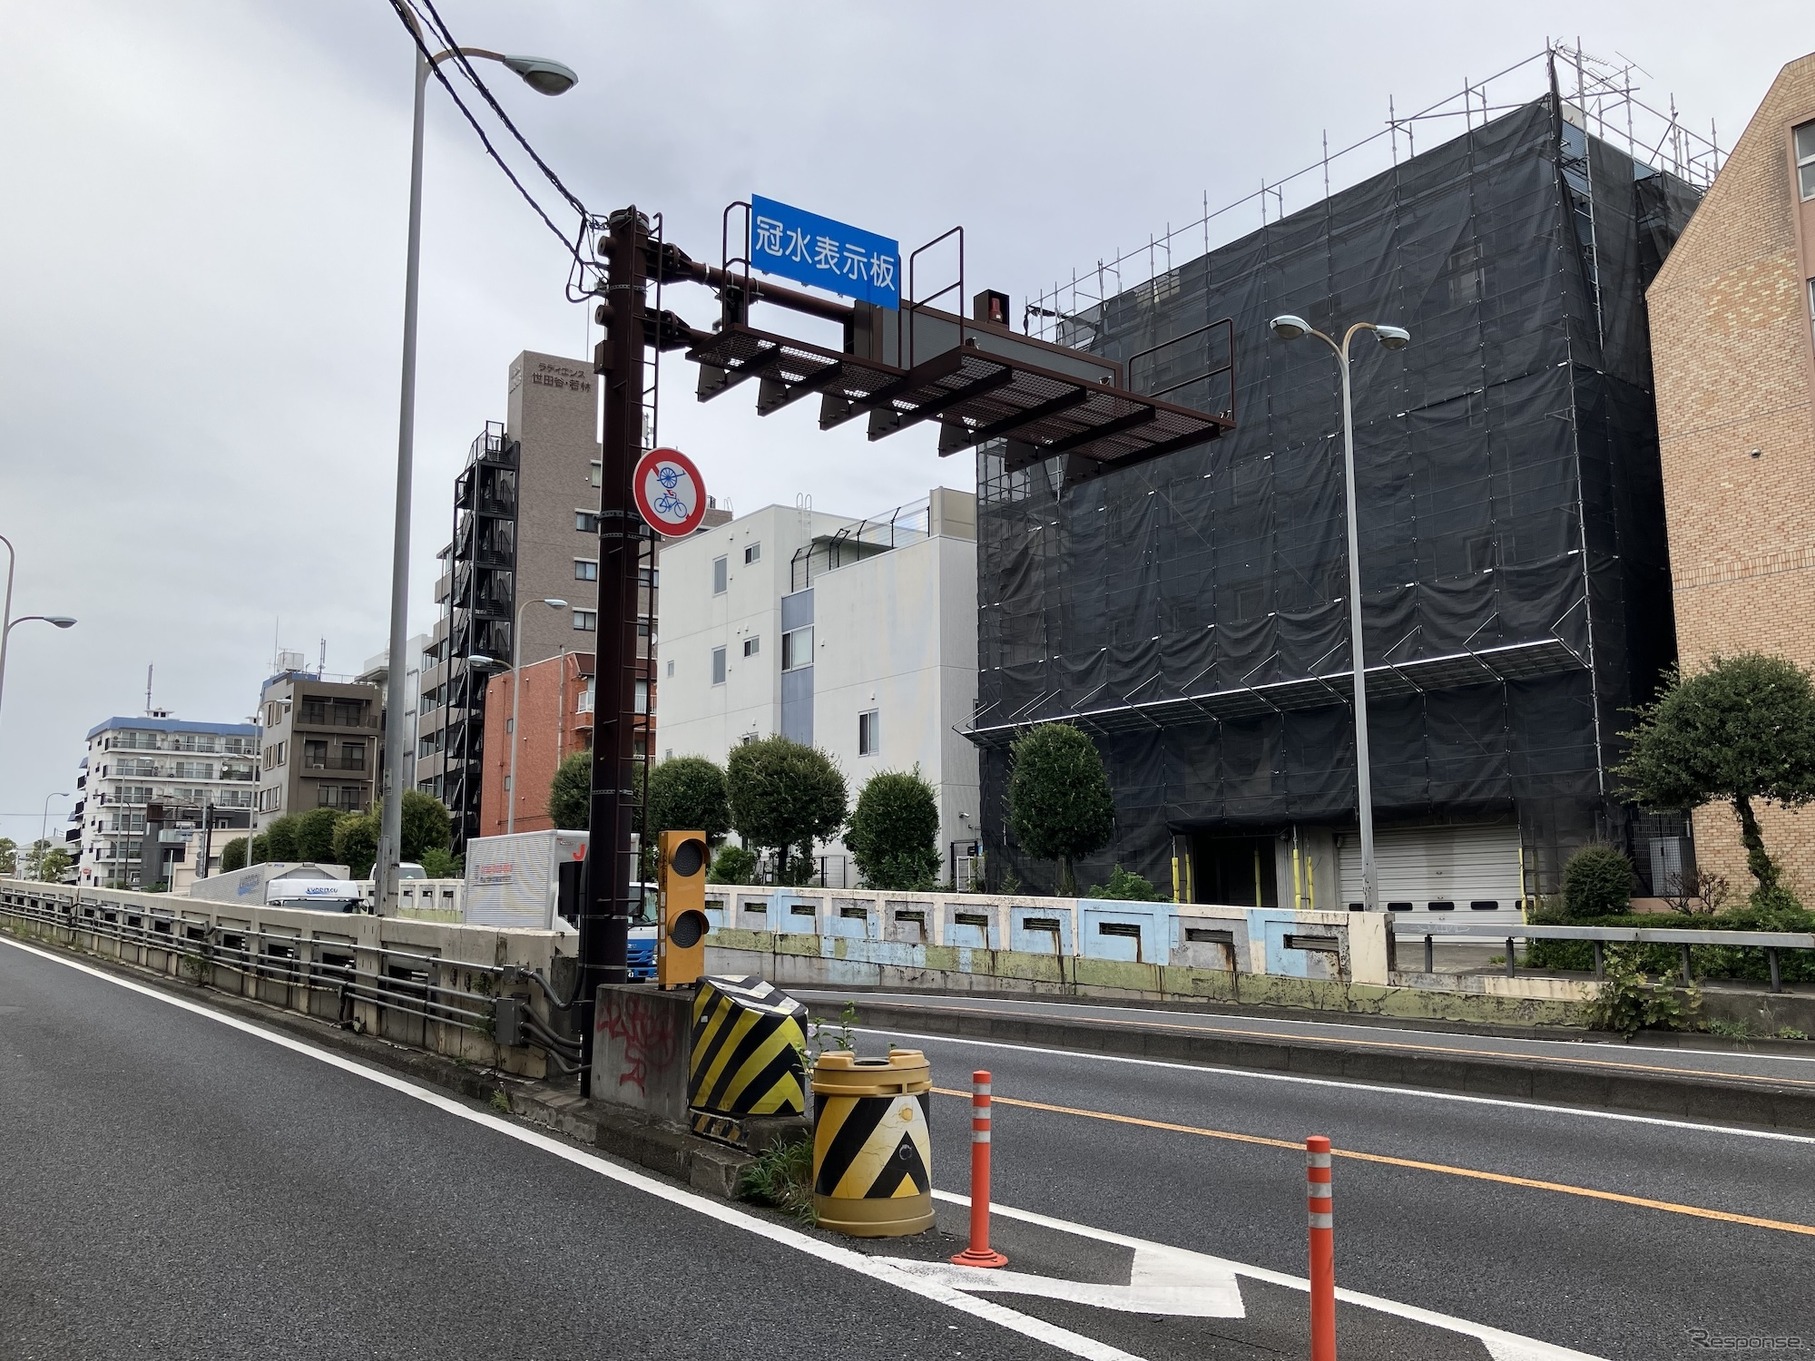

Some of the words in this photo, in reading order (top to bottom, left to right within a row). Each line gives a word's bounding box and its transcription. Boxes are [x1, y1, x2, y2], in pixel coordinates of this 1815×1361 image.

[756, 215, 895, 291] 冠水表示板
